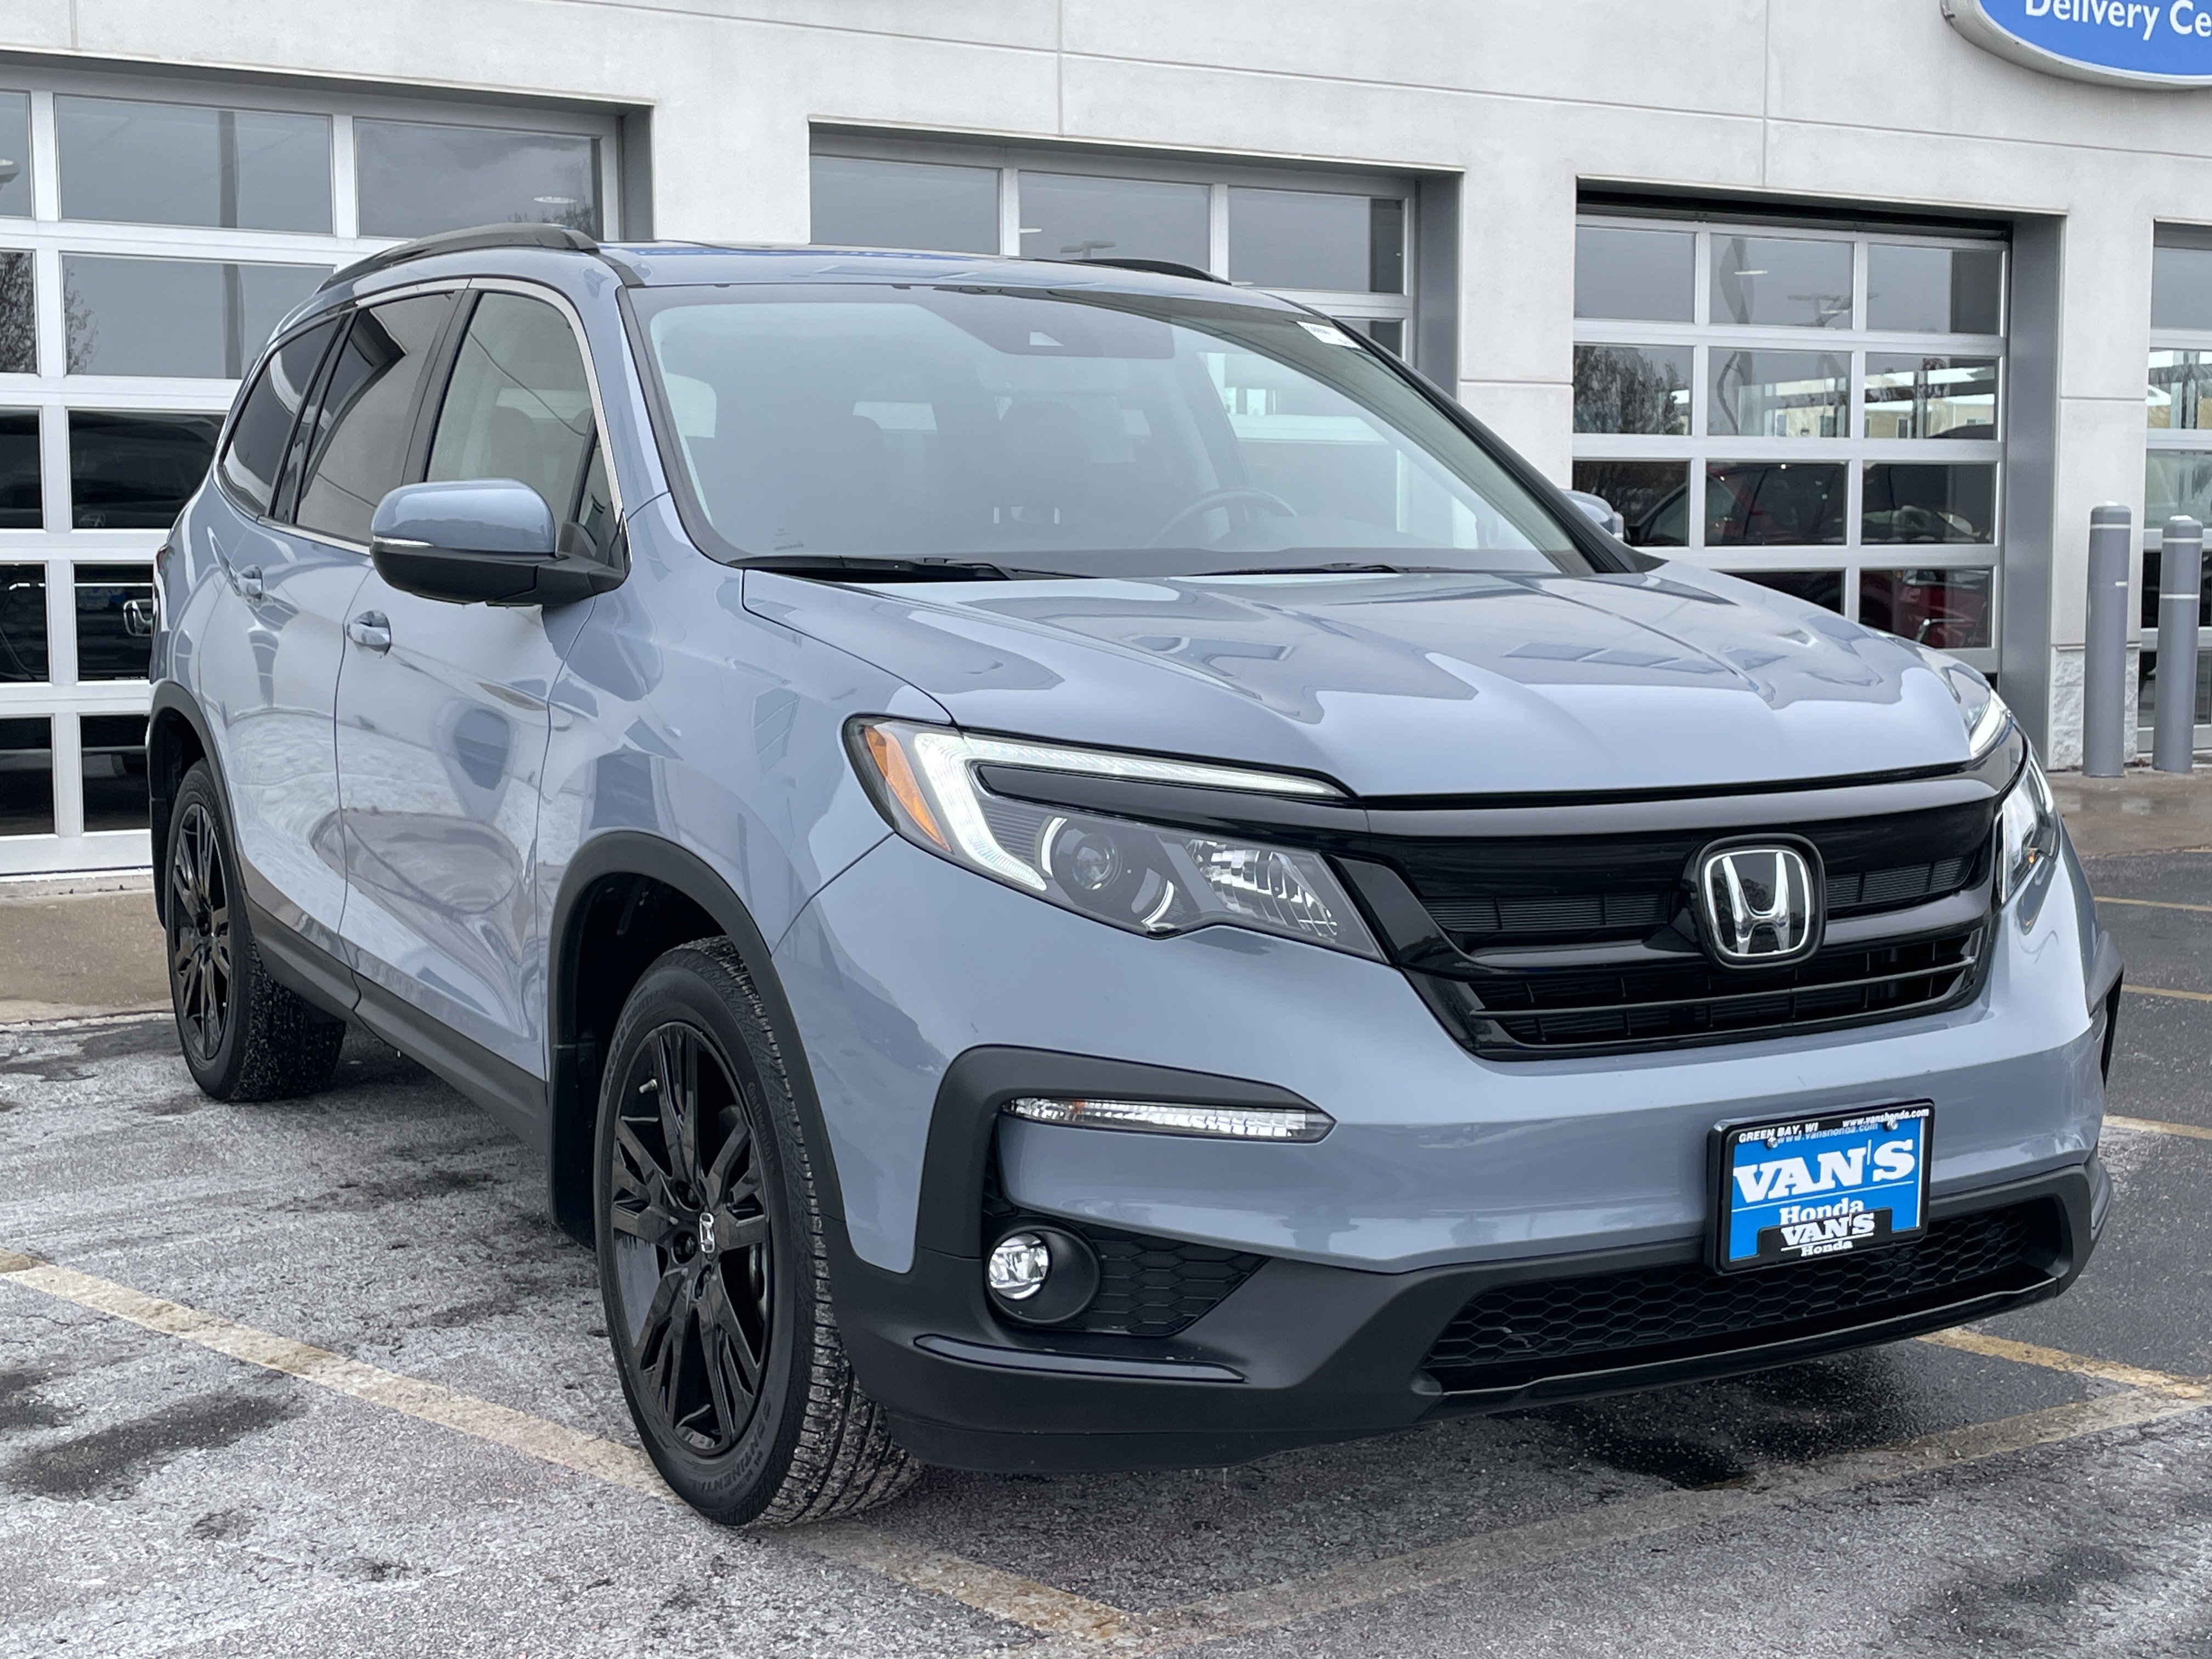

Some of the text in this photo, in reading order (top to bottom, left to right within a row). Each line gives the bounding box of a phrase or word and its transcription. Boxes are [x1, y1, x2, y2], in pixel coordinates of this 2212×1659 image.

[1842, 1108, 1929, 1127] www.vanshonda.com
[1739, 1122, 1819, 1144] GREEN BAY, WI
[1733, 1138, 1915, 1204] VAN'S
[1780, 1197, 1864, 1226] Honda
[1780, 1212, 1875, 1246] VAN'S
[1801, 1240, 1853, 1257] Honda
